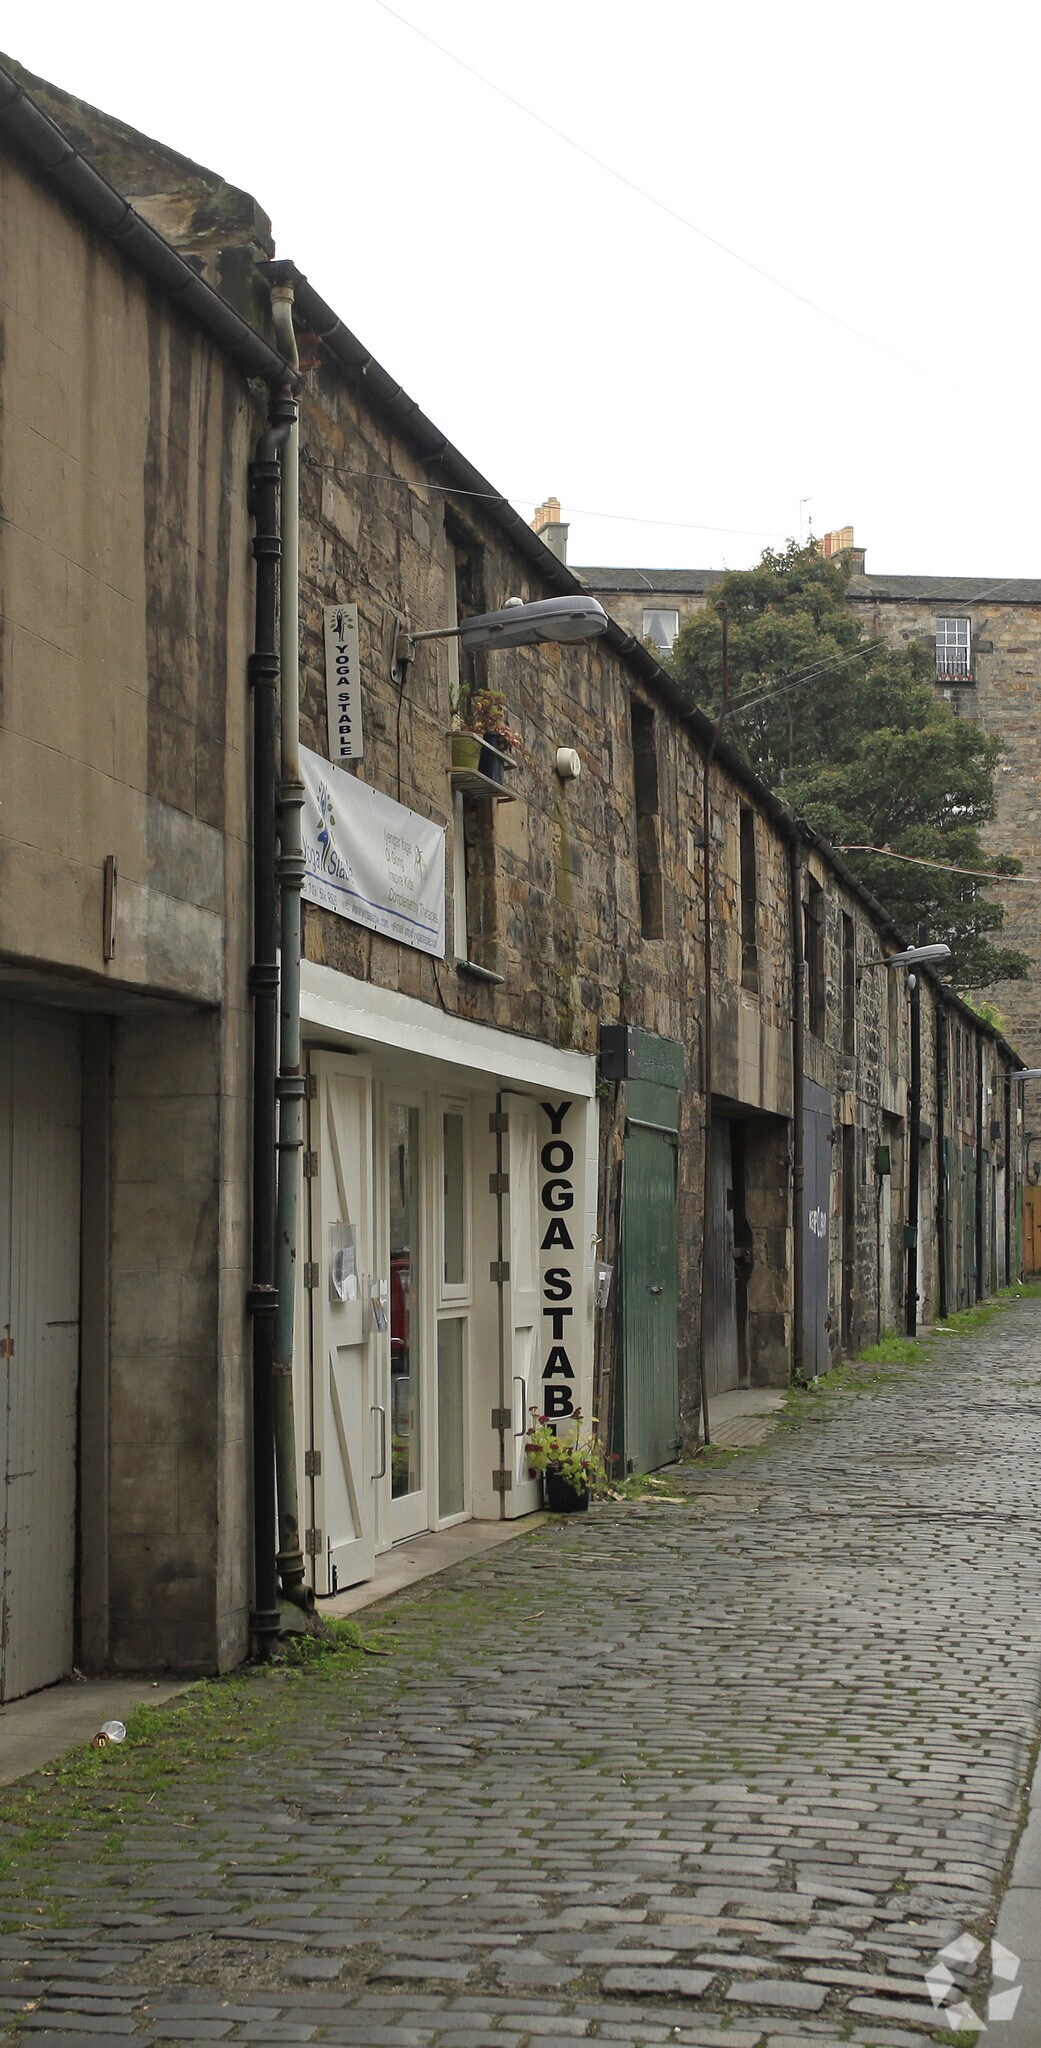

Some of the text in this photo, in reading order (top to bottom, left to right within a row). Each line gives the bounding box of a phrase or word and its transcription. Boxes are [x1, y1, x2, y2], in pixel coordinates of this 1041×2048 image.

[336, 644, 352, 756] YOGA STABLE
[540, 1102, 574, 1250] YOGA
